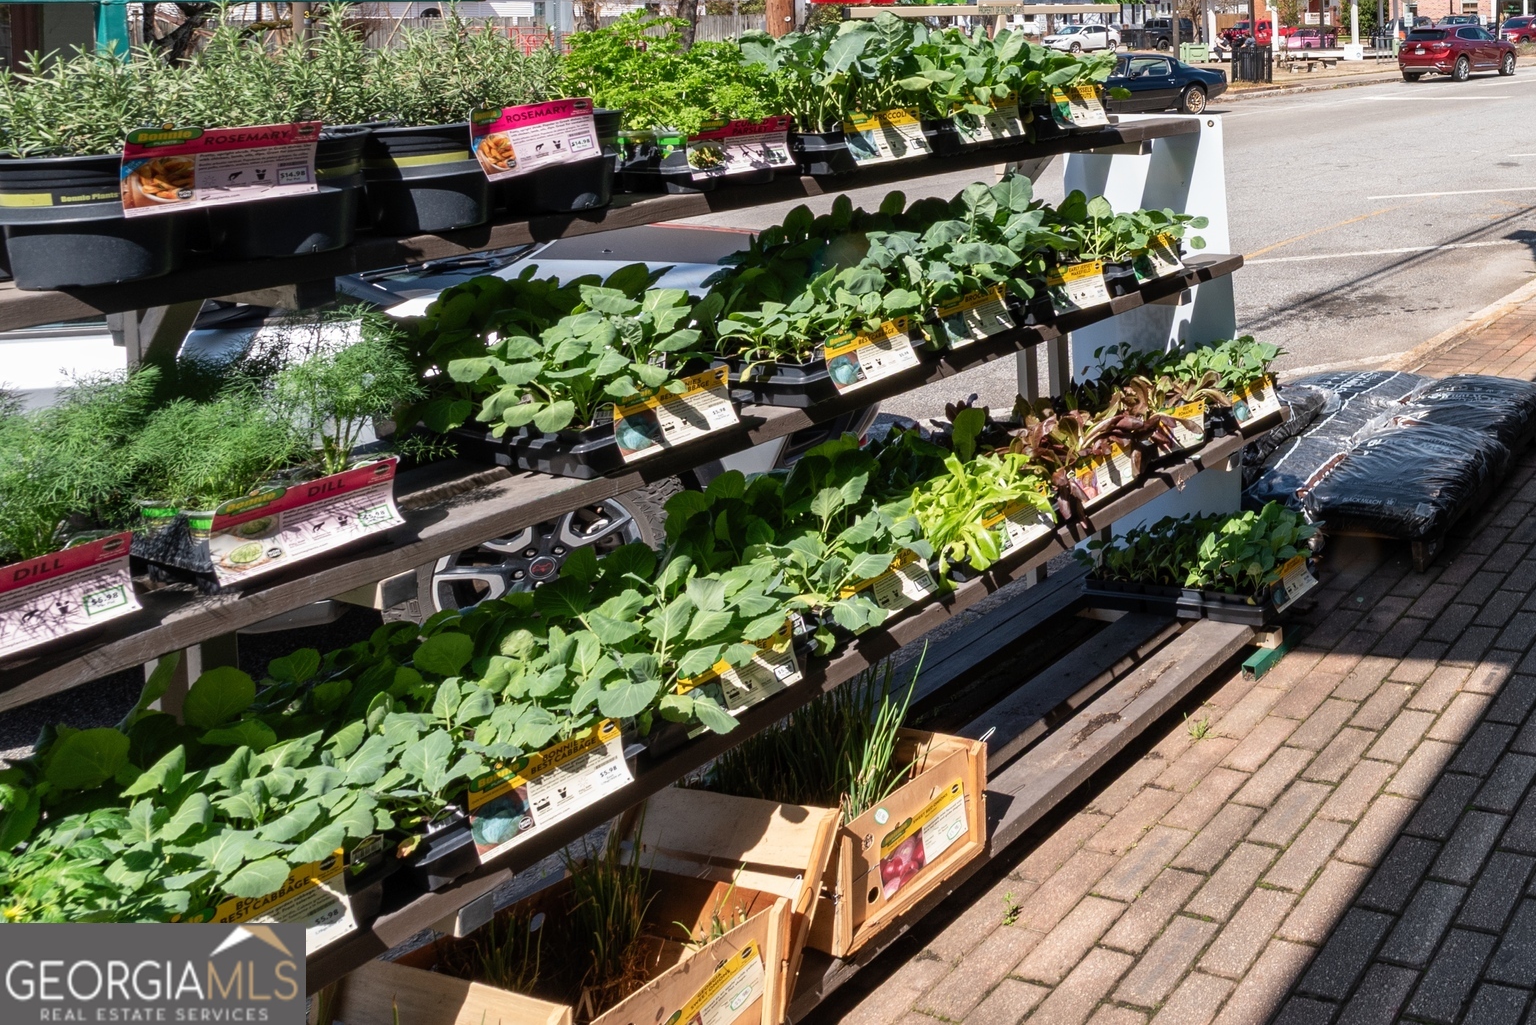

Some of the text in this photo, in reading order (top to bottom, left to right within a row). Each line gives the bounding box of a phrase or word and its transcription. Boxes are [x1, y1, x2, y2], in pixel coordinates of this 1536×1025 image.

[506, 105, 568, 123] ROSEMARY
[873, 110, 907, 121] BROCCOLI
[138, 129, 290, 146] Bonnie ROSEMARY
[732, 125, 767, 135] PARSLEY
[571, 138, 590, 147] $14.98
[280, 170, 305, 180] $14.98
[660, 393, 676, 401] BEST
[308, 479, 345, 497] DILL
[226, 492, 276, 512] Bonnie
[13, 558, 64, 582] DILL
[531, 737, 597, 775] BEST CABBAGE
[600, 765, 618, 778] $5.98
[220, 909, 250, 923] BEST
[253, 876, 310, 911] CABBAGE
[315, 908, 339, 925] $5.98
